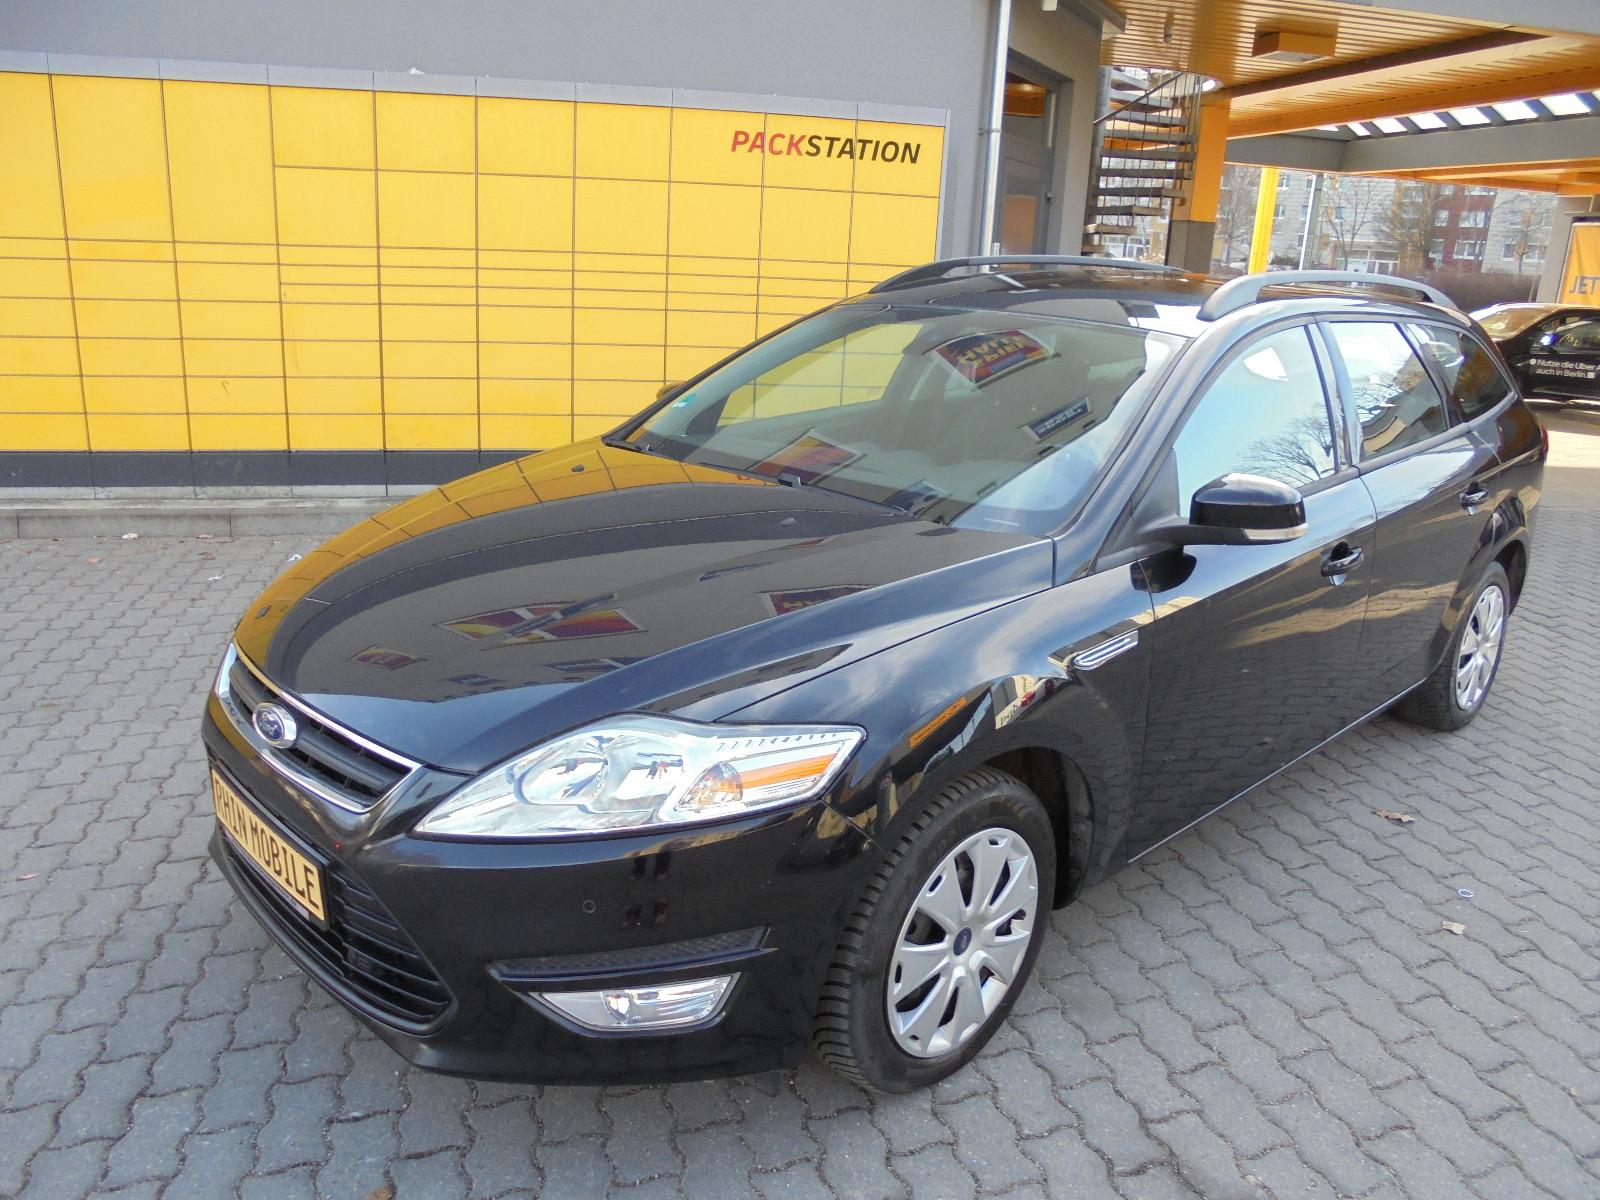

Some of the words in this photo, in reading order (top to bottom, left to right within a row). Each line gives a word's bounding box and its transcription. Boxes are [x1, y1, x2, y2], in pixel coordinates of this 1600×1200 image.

[731, 130, 921, 164] PACKSTATION
[1569, 275, 1600, 295] JET
[1537, 358, 1560, 368] Nutze
[1561, 361, 1574, 369] die
[250, 817, 320, 910] MOBILE
